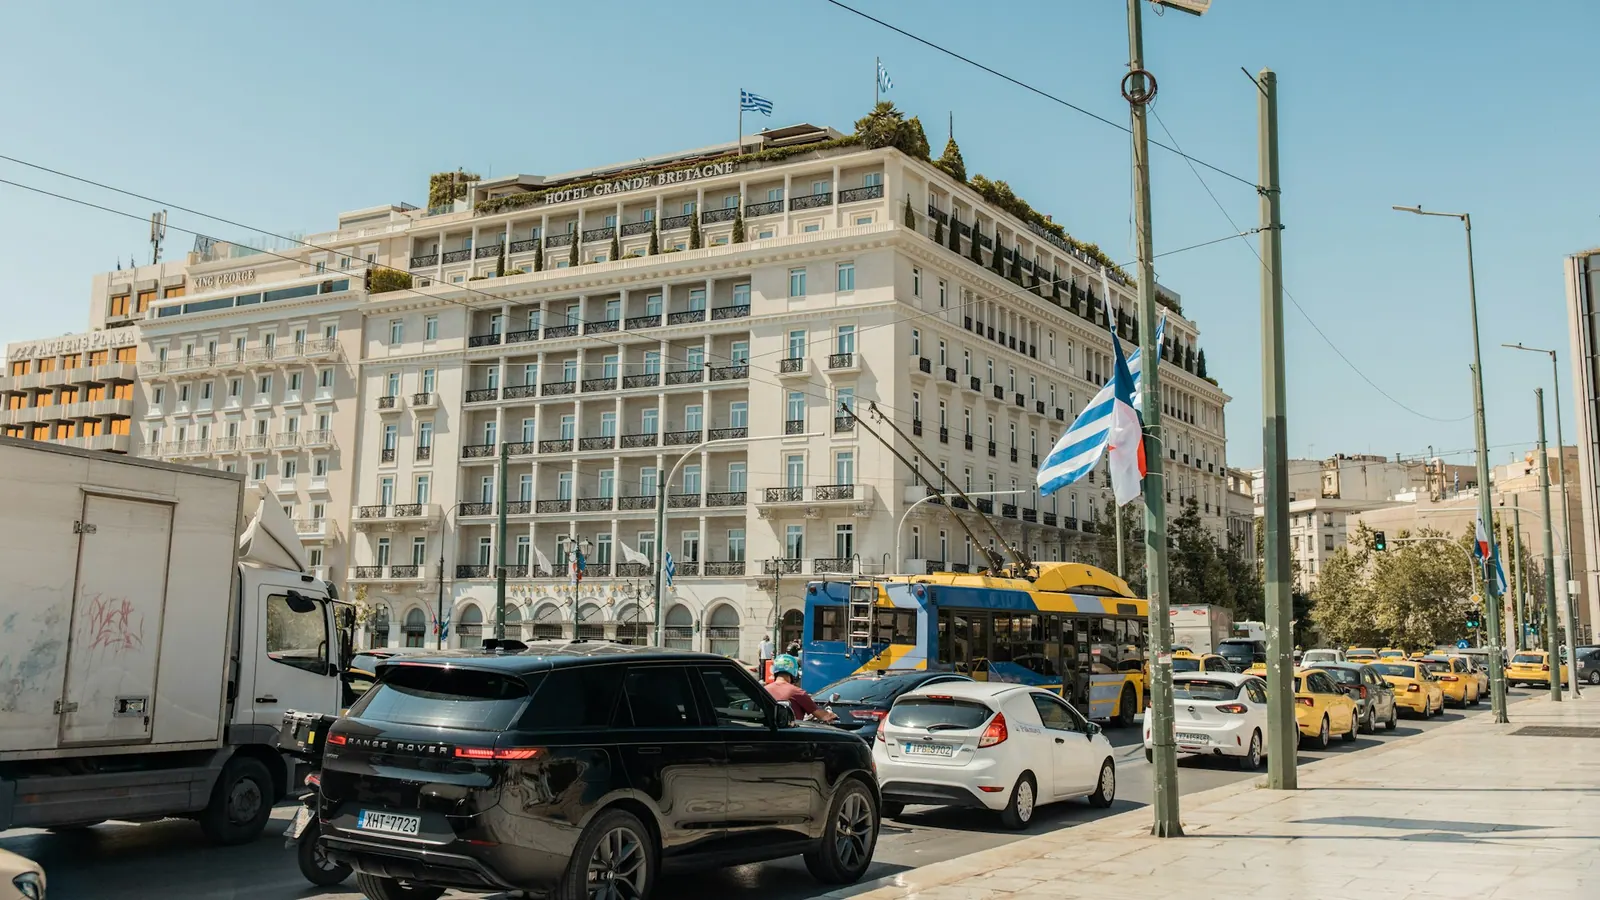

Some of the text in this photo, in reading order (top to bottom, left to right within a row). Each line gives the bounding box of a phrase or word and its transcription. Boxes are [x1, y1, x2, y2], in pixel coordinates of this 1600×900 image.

[545, 162, 734, 204] HOTEL GRANDE BRETAGNE
[193, 269, 254, 288] KING GEORGE
[39, 336, 89, 356] ATHENS
[92, 331, 135, 349] PLAZA
[347, 738, 449, 754] RANGE ROVER
